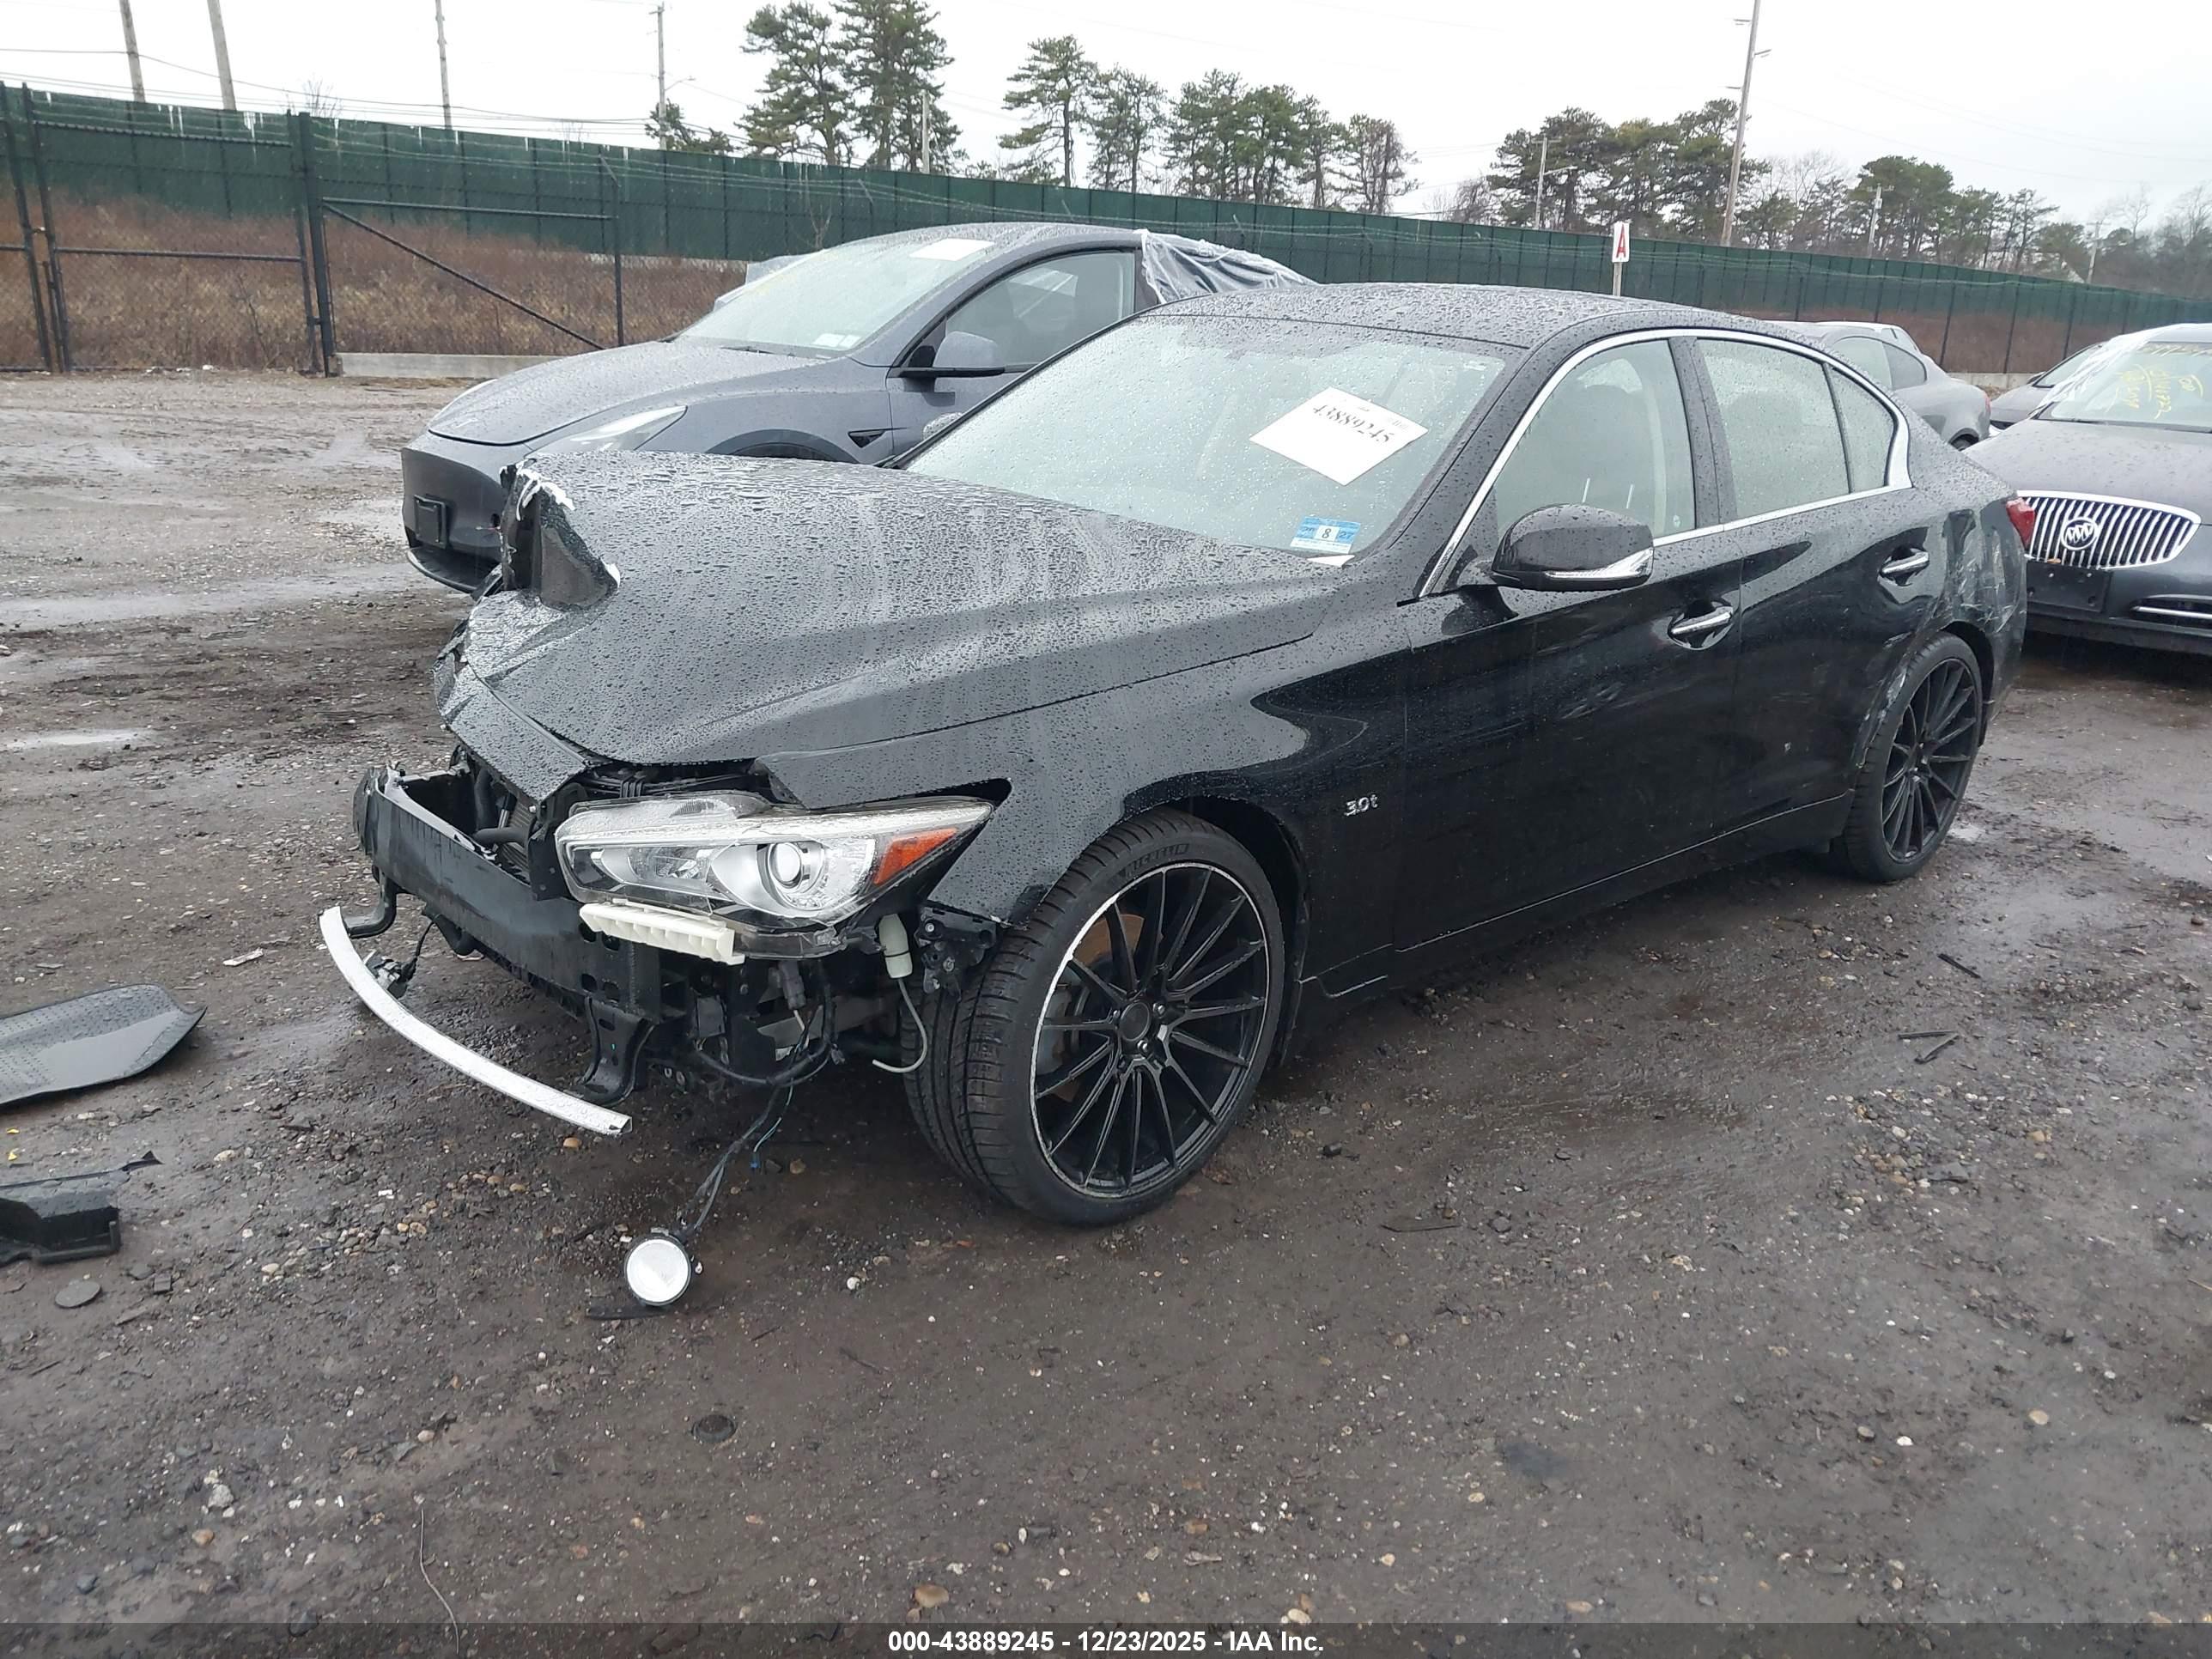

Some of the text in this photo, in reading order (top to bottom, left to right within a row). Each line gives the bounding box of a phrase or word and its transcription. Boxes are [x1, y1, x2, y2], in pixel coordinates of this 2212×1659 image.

[1616, 223, 1626, 258] A
[1312, 404, 1395, 443] 43889245
[1321, 527, 1333, 539] 8
[1339, 530, 1355, 540] 27
